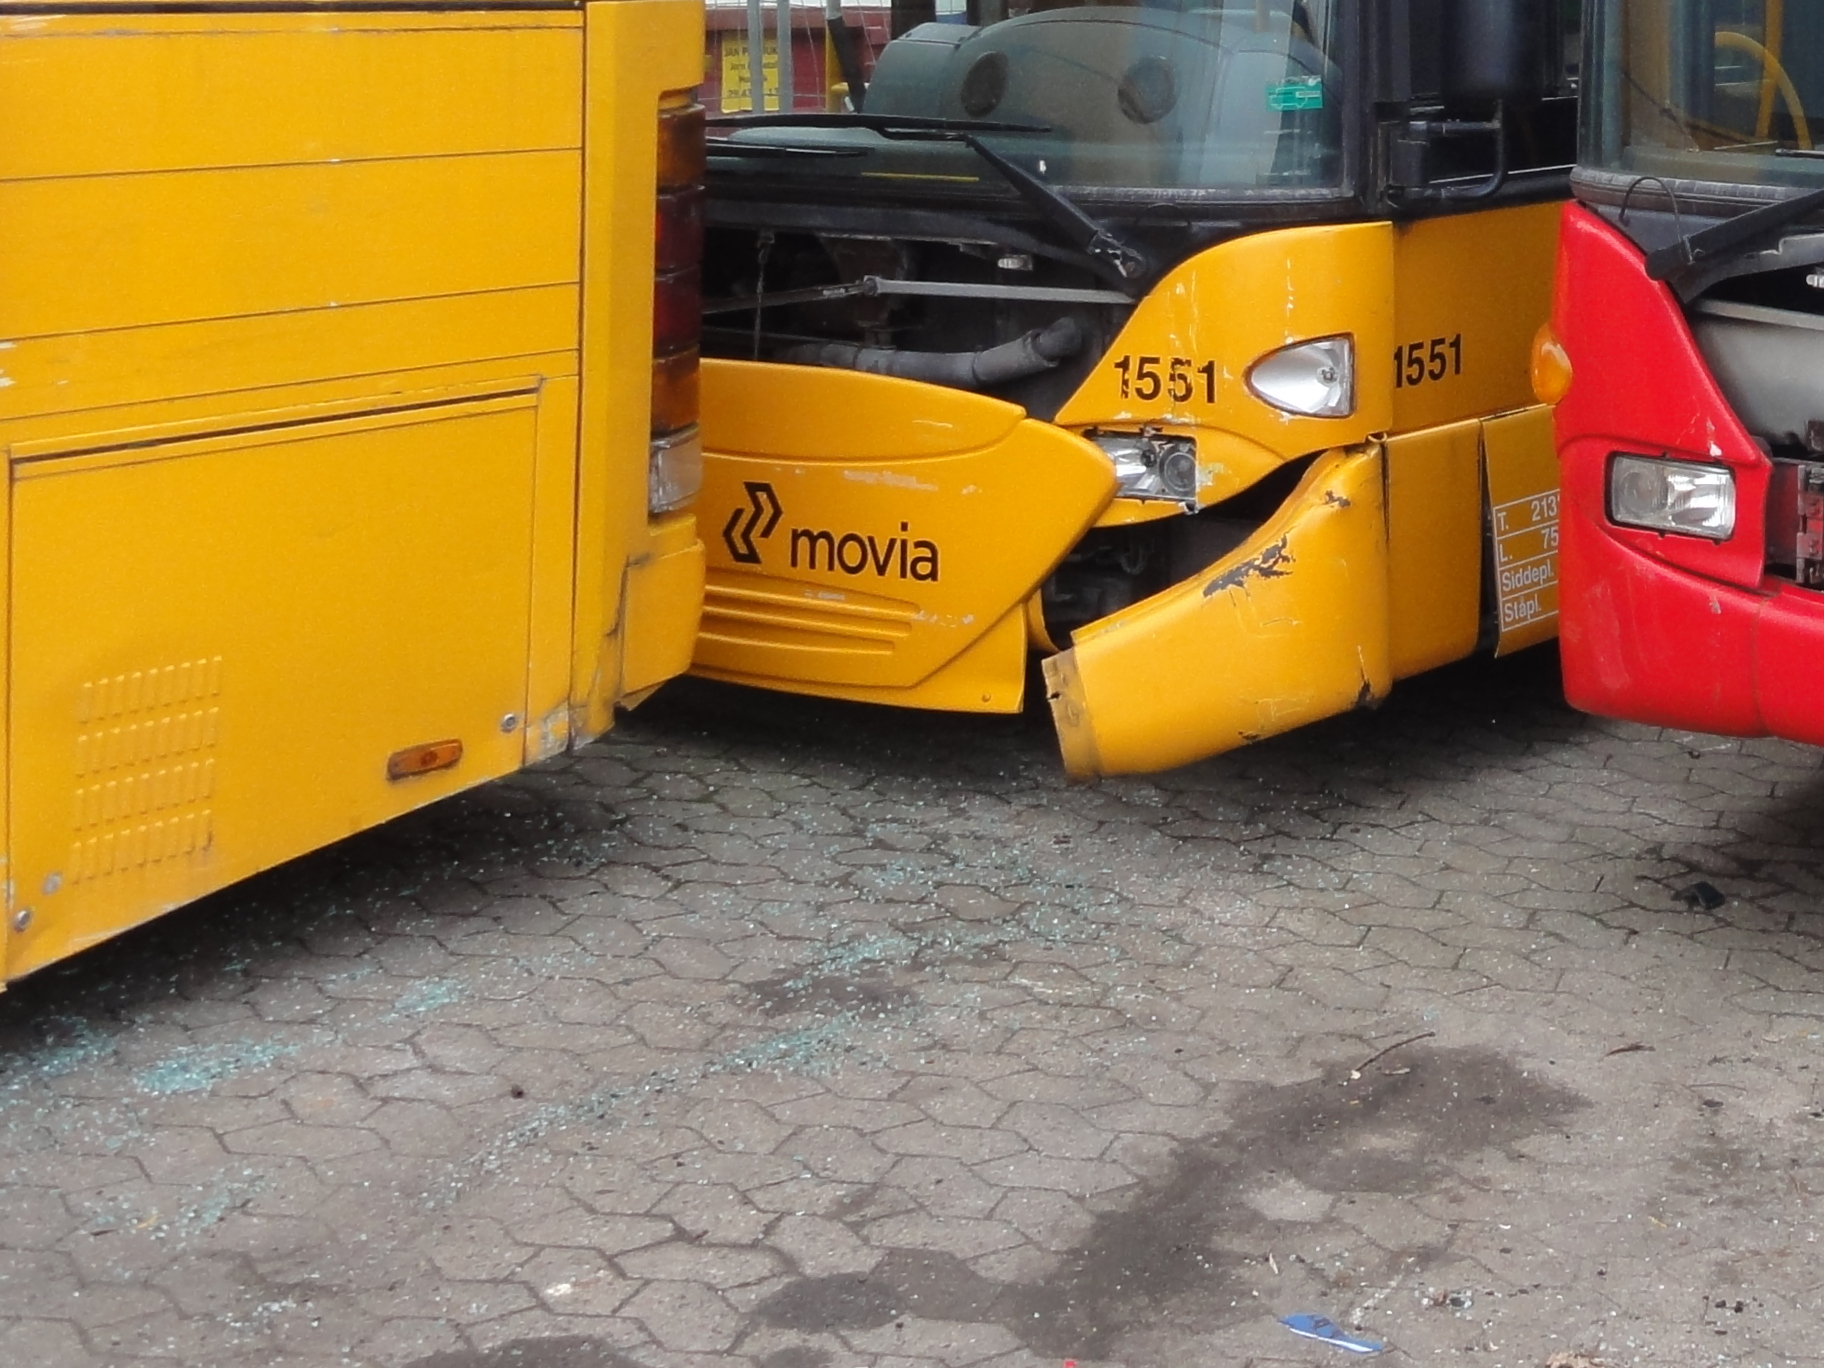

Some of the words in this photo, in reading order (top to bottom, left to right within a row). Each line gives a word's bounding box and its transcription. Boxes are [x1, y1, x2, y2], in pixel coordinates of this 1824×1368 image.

[1114, 353, 1217, 404] 1551
[1395, 334, 1463, 388] 1551
[1497, 511, 1509, 531] T.
[1531, 494, 1560, 522] 213
[789, 522, 940, 582] movia
[1500, 543, 1513, 563] L.
[1502, 558, 1554, 593] Siddepl.
[1504, 594, 1542, 622] Ståpl.
